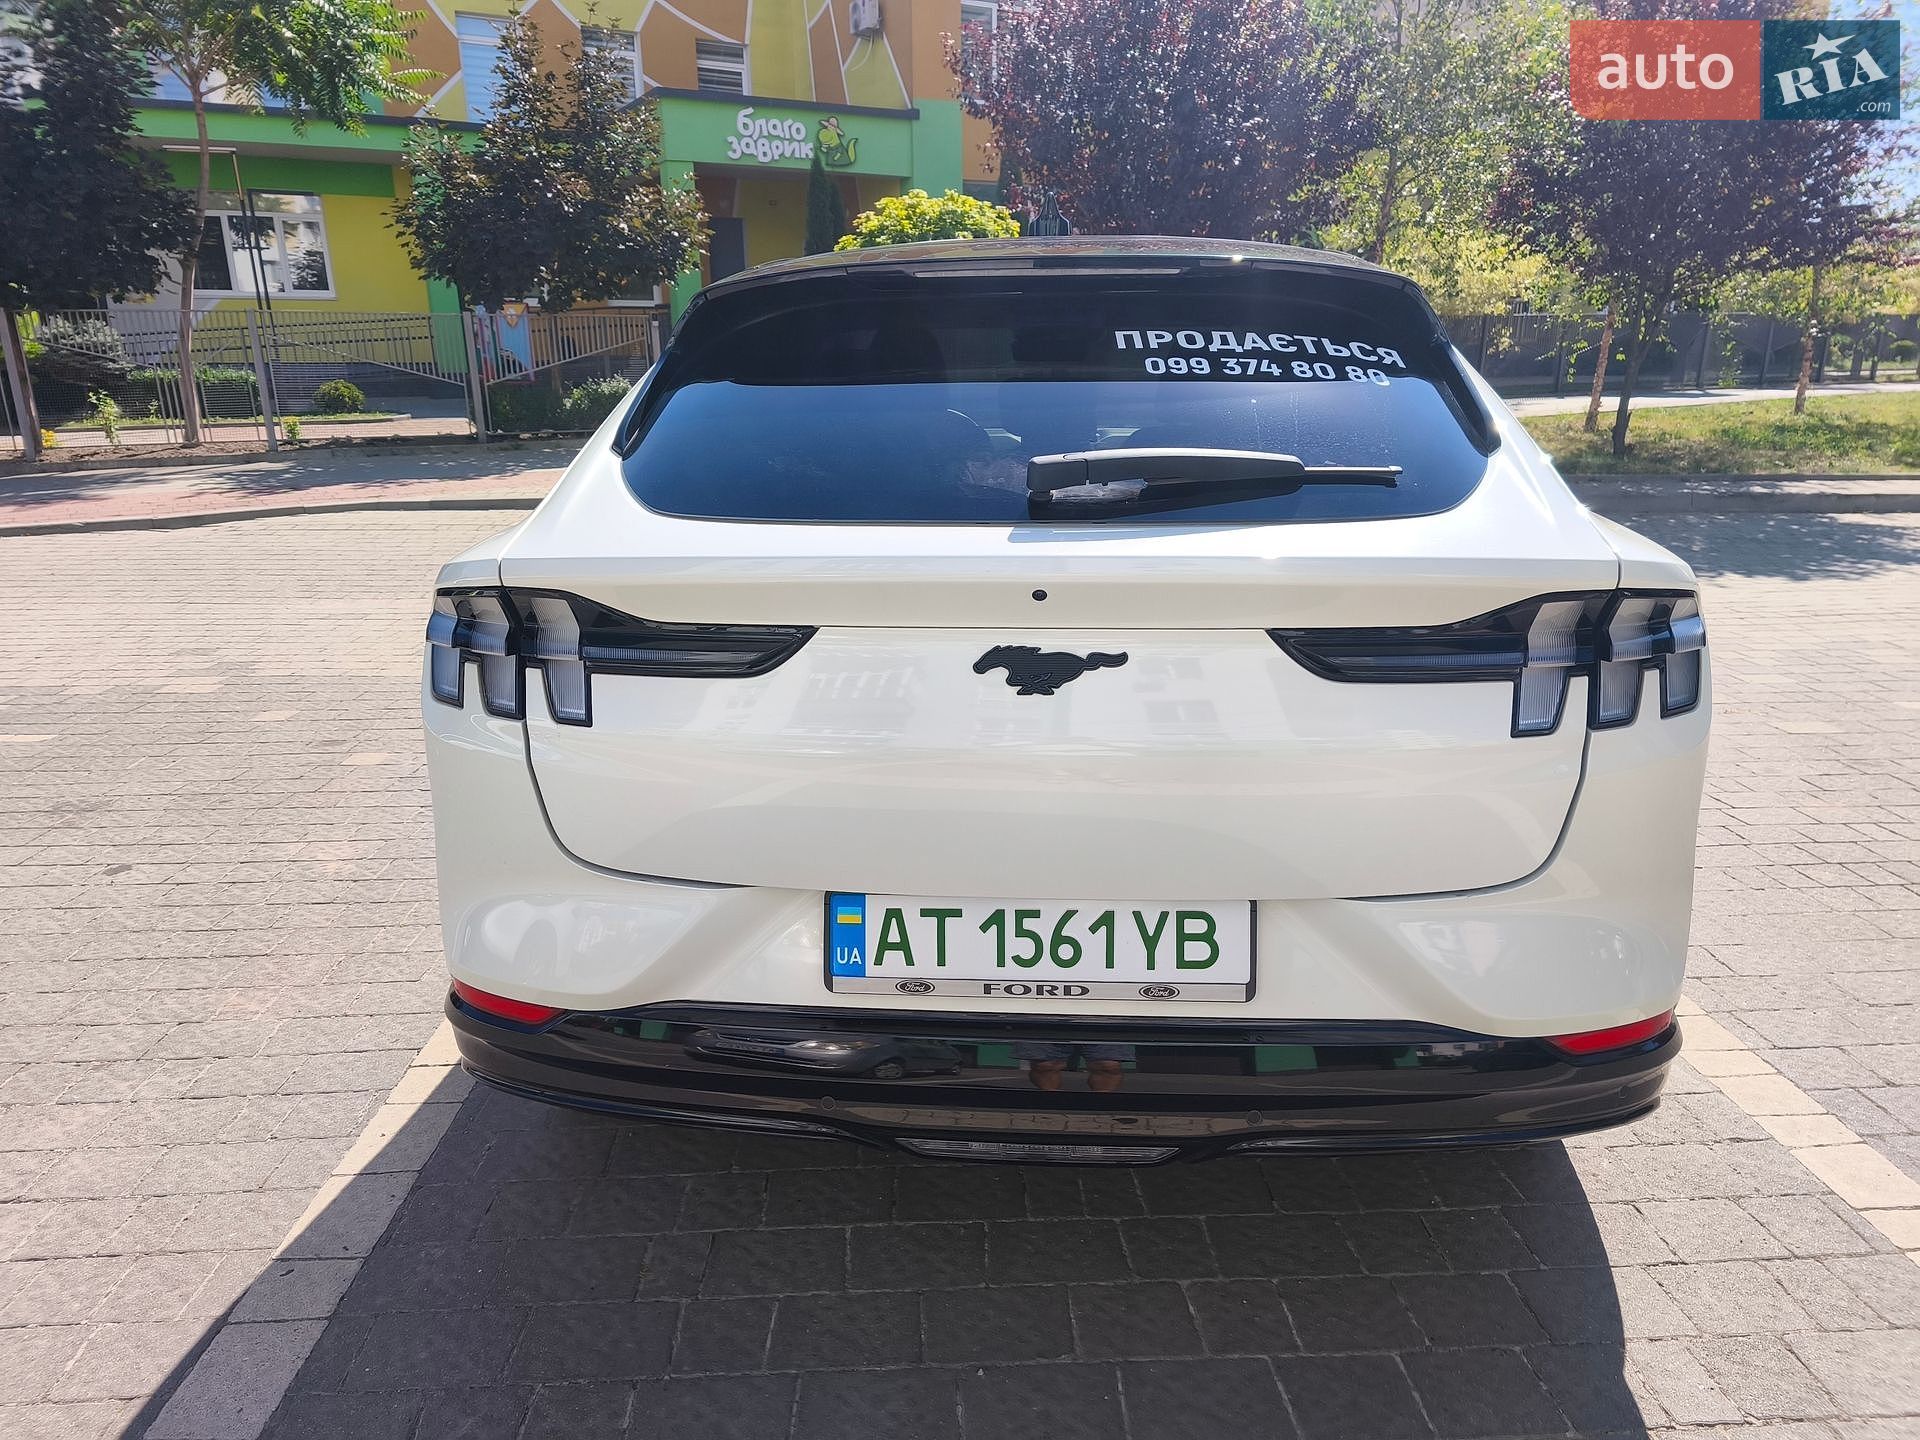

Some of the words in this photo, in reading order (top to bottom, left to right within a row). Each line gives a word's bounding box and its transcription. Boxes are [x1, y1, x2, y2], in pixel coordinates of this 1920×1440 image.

[736, 106, 807, 141] благо
[727, 135, 815, 163] заврик
[1114, 330, 1407, 369] ПРОДАЄТЬСЯ
[1144, 356, 1211, 375] 099
[1220, 357, 1283, 377] 374
[1290, 360, 1337, 380] 80
[1347, 365, 1391, 386] 80
[836, 947, 863, 965] UA
[983, 983, 1090, 997] FORD
